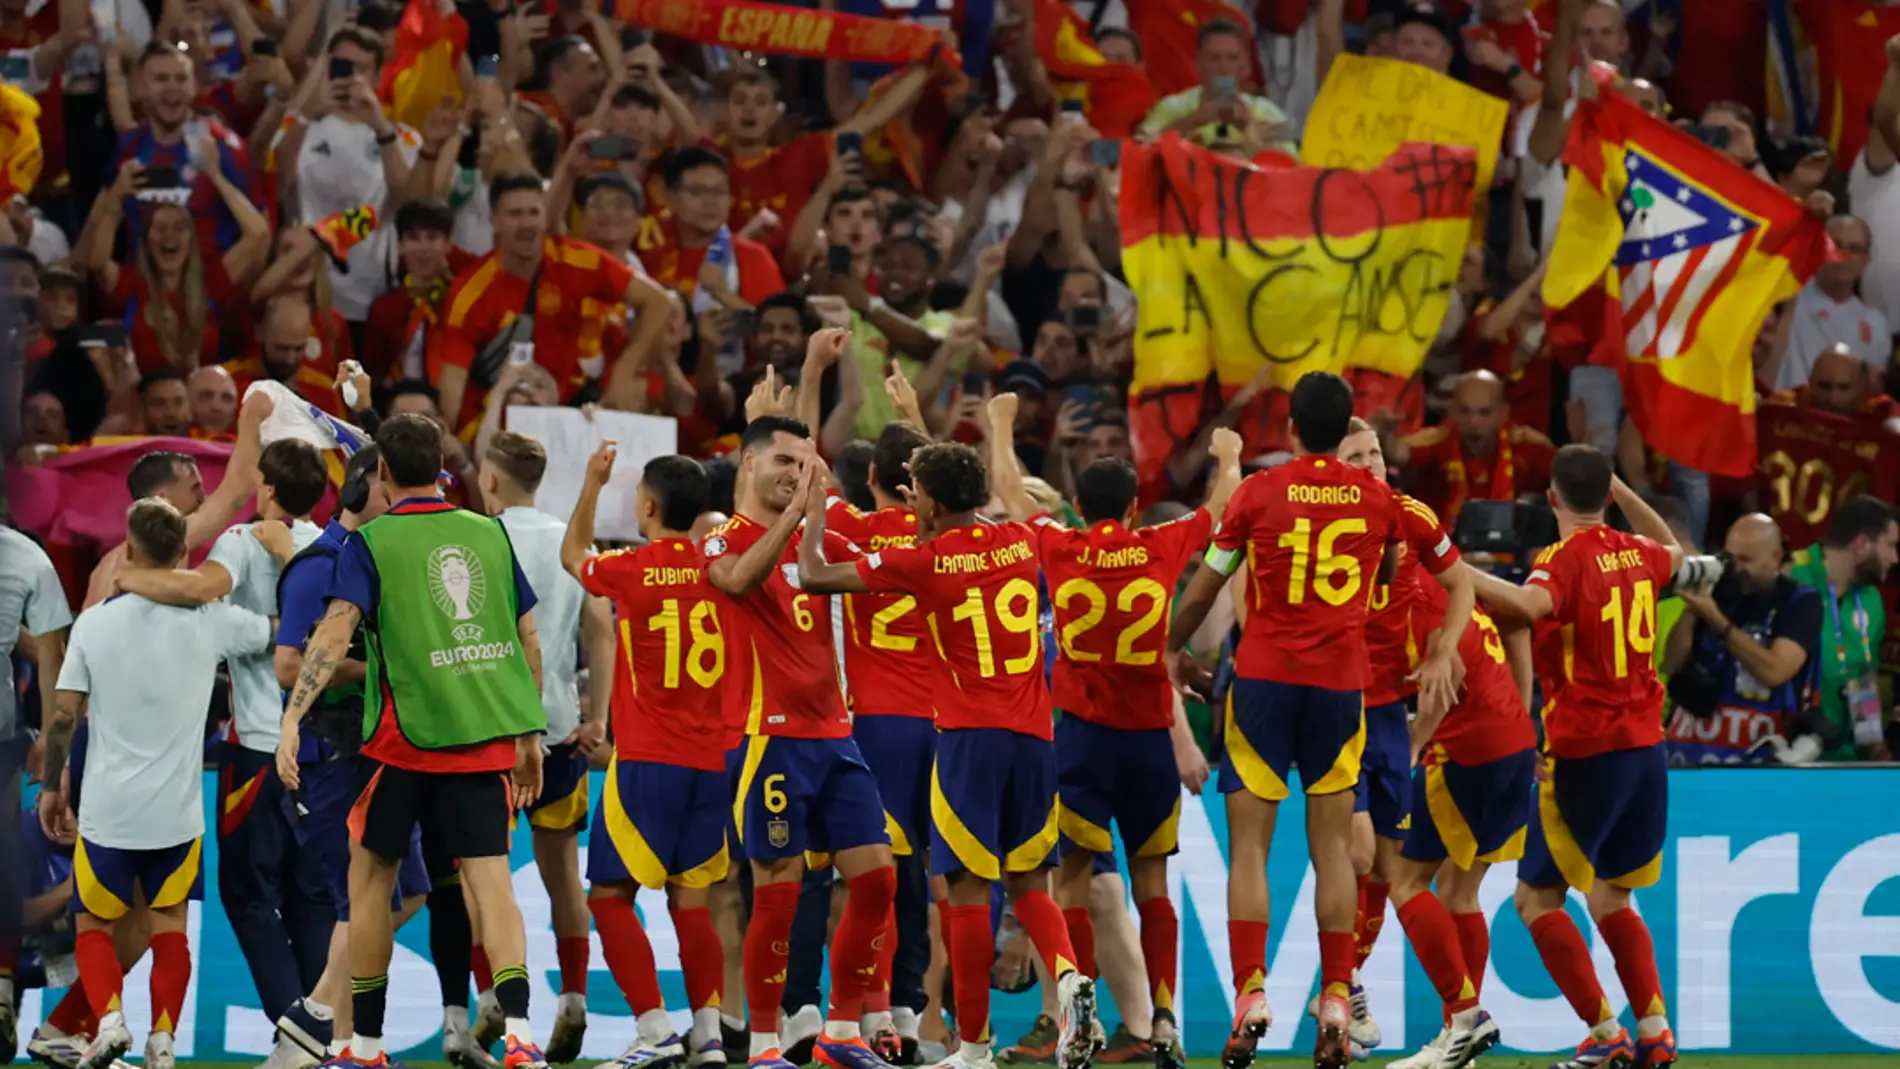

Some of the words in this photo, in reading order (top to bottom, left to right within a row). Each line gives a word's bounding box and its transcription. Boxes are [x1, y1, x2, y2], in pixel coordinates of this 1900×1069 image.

[1157, 152, 1385, 264] NICO
[1287, 484, 1361, 505] RODRIGO
[934, 551, 989, 574] LAMINE
[1076, 546, 1093, 566] J.
[1096, 546, 1149, 569] NAVAS
[1278, 517, 1368, 607] 16
[648, 598, 724, 689] 18
[792, 593, 814, 632] 6
[952, 577, 1039, 678] 19
[1055, 577, 1167, 666] 22
[1601, 579, 1657, 678] 14
[764, 773, 788, 814] 6
